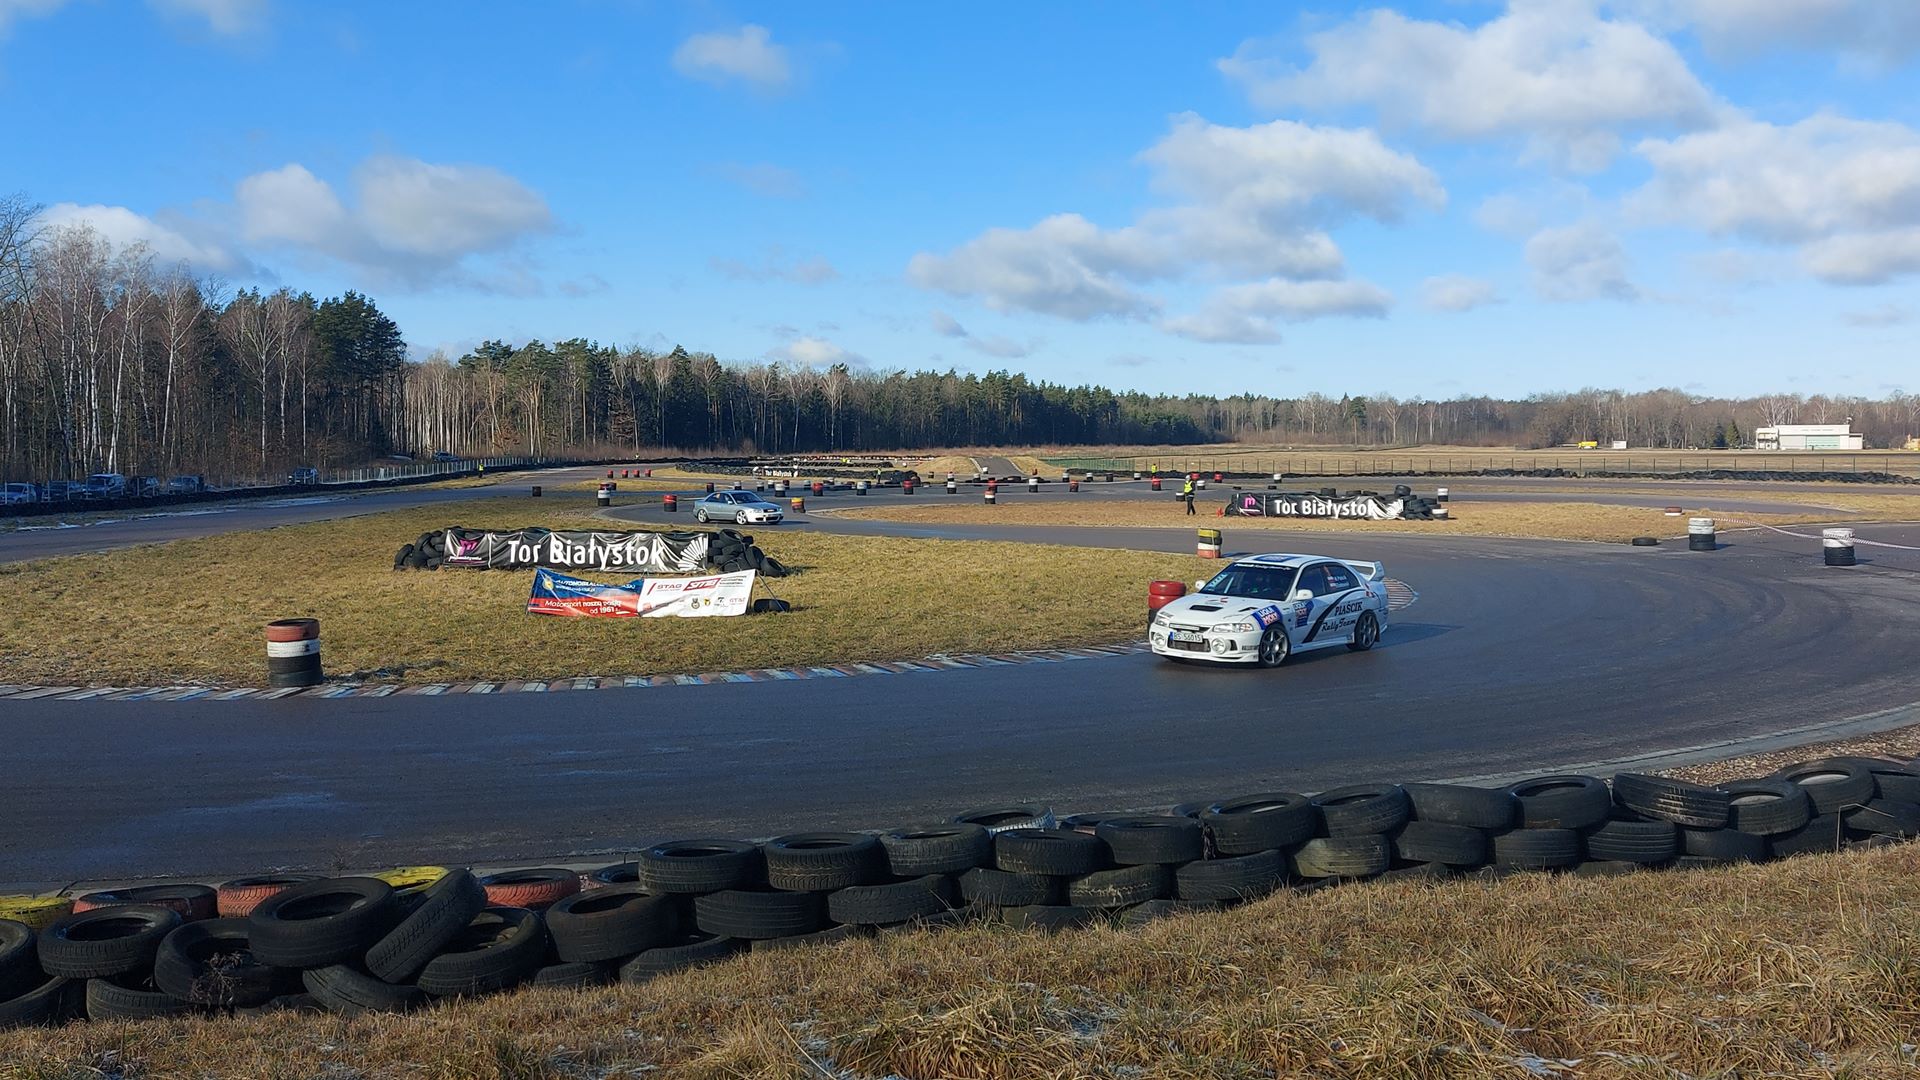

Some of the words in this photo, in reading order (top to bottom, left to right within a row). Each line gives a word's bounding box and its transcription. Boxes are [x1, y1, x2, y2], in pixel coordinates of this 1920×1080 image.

[1275, 499, 1298, 515] Tor
[508, 540, 541, 563] Tor
[550, 538, 663, 570] Białystok
[544, 600, 582, 608] Motorsport
[589, 606, 599, 614] od
[1334, 600, 1363, 616] PIAŚCIK
